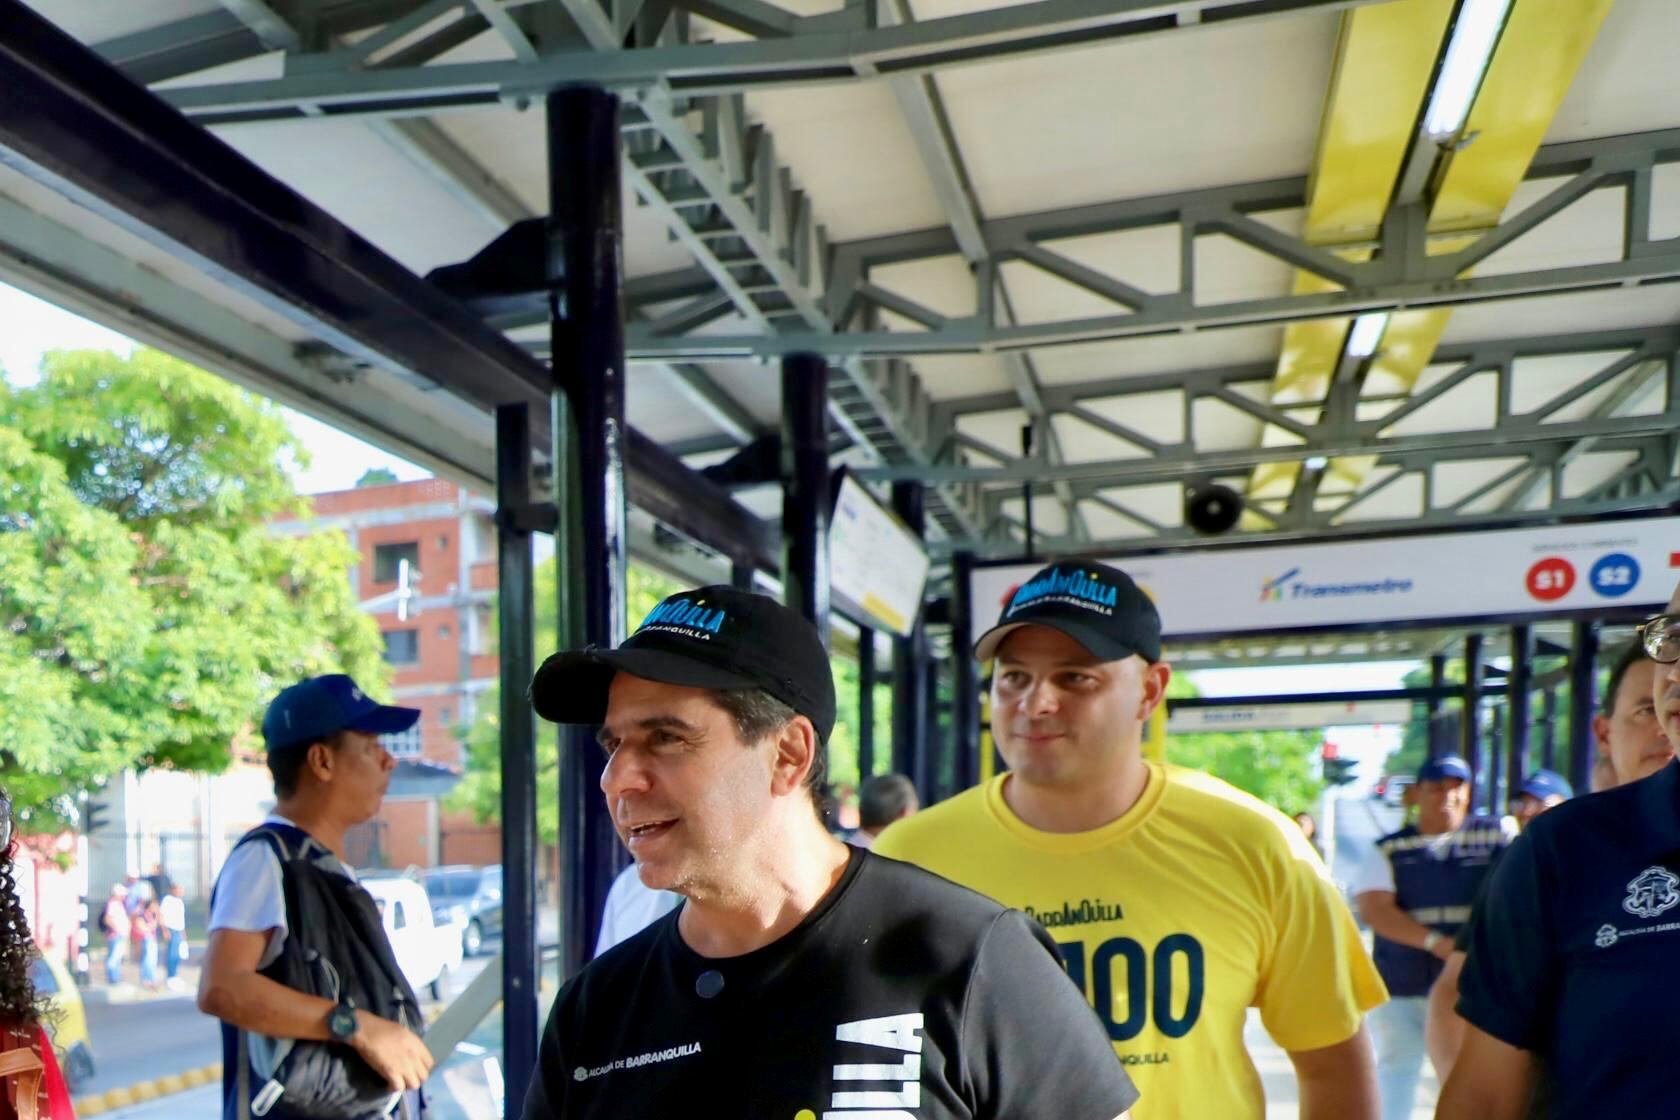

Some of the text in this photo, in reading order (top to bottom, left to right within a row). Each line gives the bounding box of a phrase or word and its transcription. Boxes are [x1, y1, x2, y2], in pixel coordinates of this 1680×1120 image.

[1534, 564, 1632, 590] S1 S2
[626, 1042, 701, 1068] BARRANQUILLA
